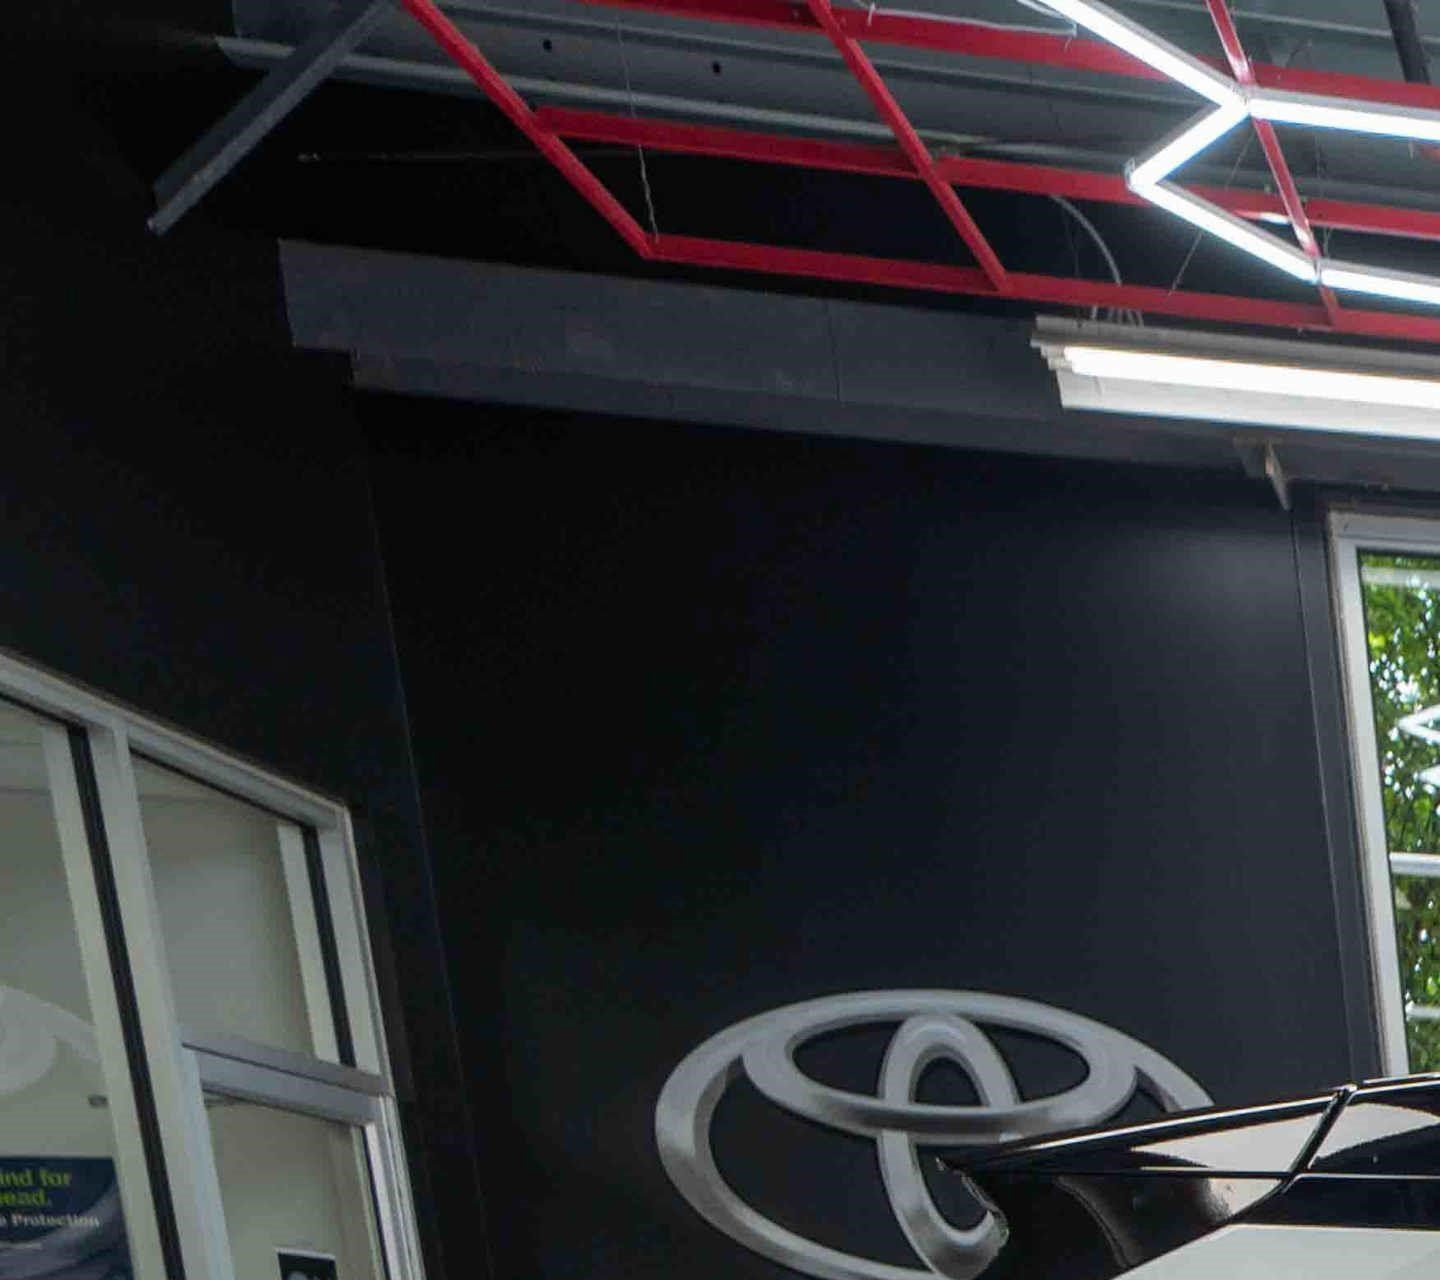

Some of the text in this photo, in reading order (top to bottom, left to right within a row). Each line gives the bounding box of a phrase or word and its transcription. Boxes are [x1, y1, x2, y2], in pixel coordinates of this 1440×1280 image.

[0, 1167, 71, 1187] ind for
[0, 1188, 52, 1207] ead.
[11, 1213, 100, 1227] Protection
